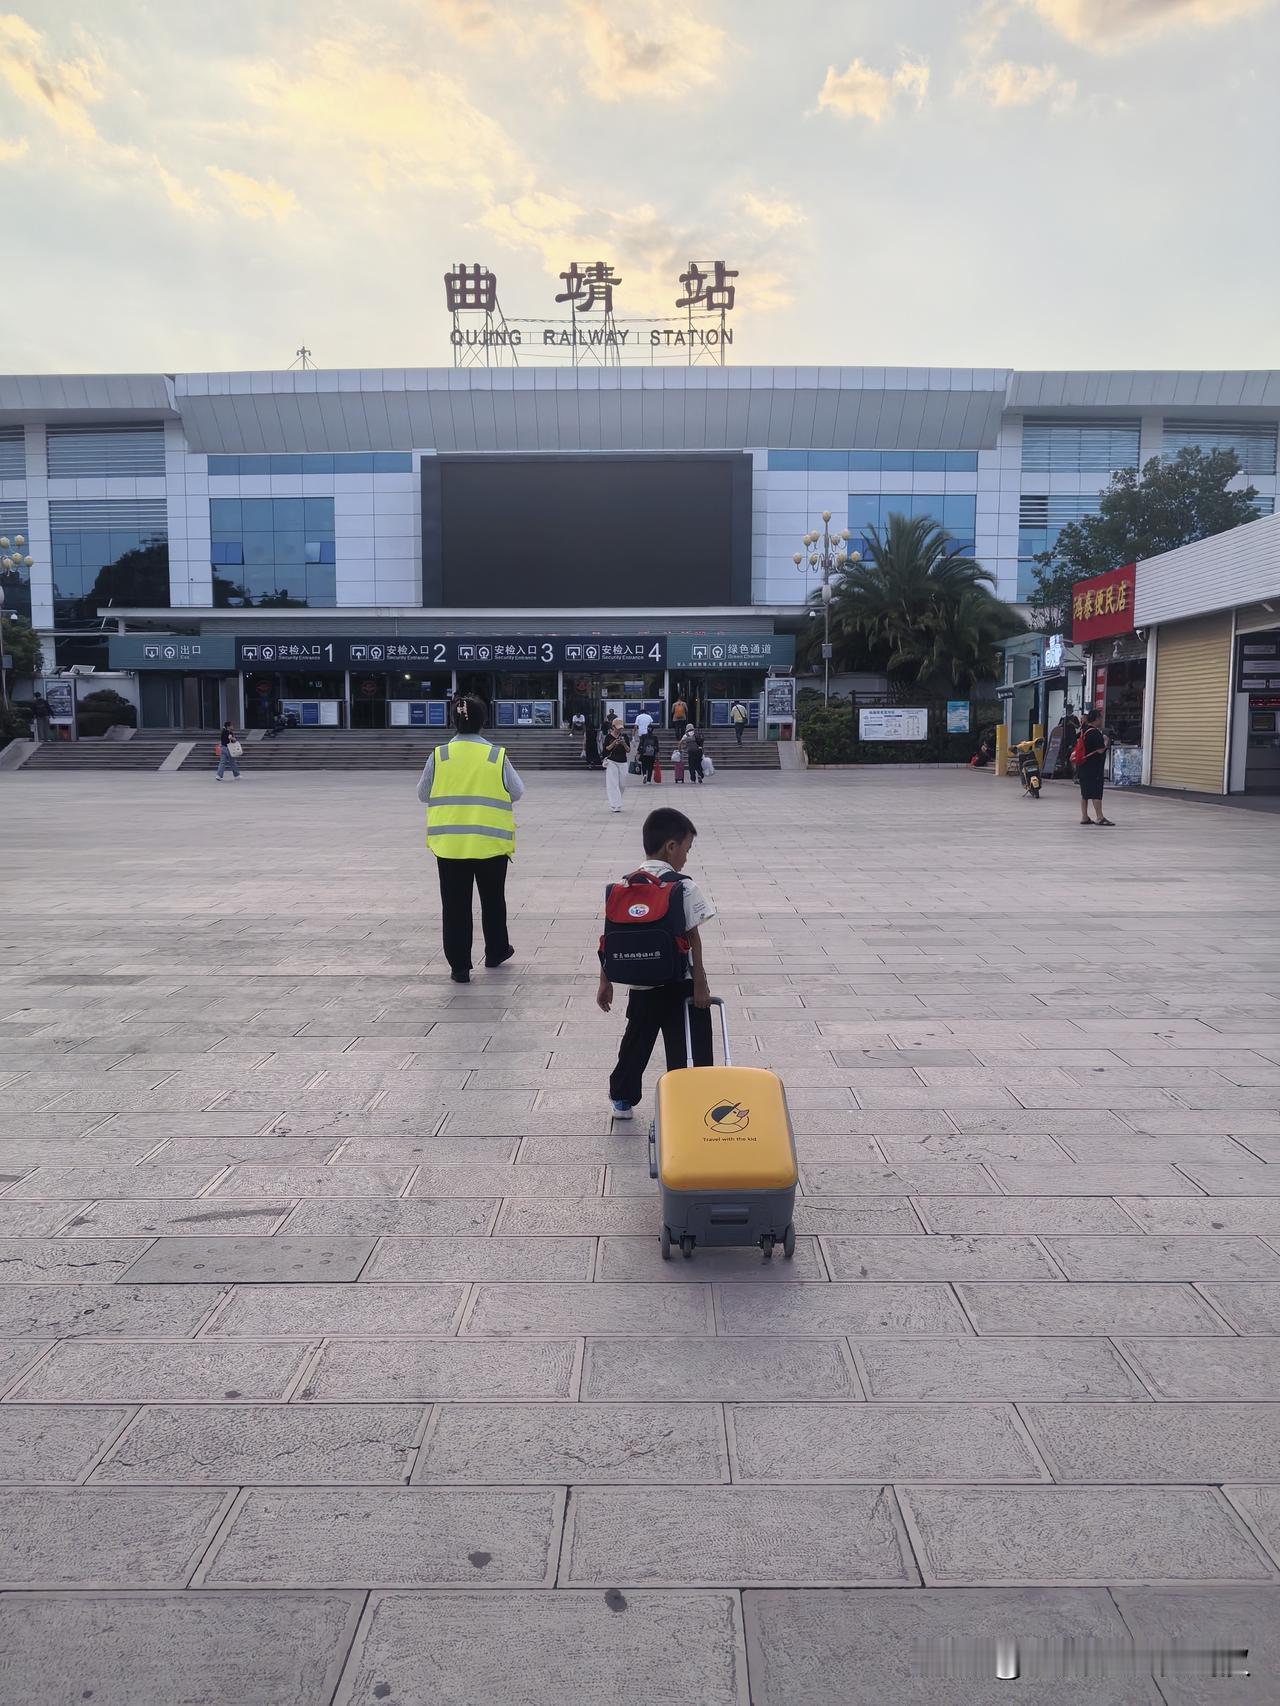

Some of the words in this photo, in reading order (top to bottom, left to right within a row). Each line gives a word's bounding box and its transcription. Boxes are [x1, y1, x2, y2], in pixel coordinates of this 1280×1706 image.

[444, 262, 739, 312] 曲靖站
[450, 329, 521, 346] QUJING
[543, 329, 629, 346] RAILWAY
[650, 328, 733, 346] STATION
[180, 644, 201, 655] 出口
[278, 645, 321, 655] 安检入口
[324, 643, 333, 662] 1
[387, 645, 429, 655] 安检入口
[433, 643, 446, 662] 2
[494, 645, 537, 655] 安检入口
[541, 643, 553, 662] 3
[602, 645, 644, 655] 安检入口
[648, 643, 662, 662] 4
[728, 644, 771, 654] 绿色通道
